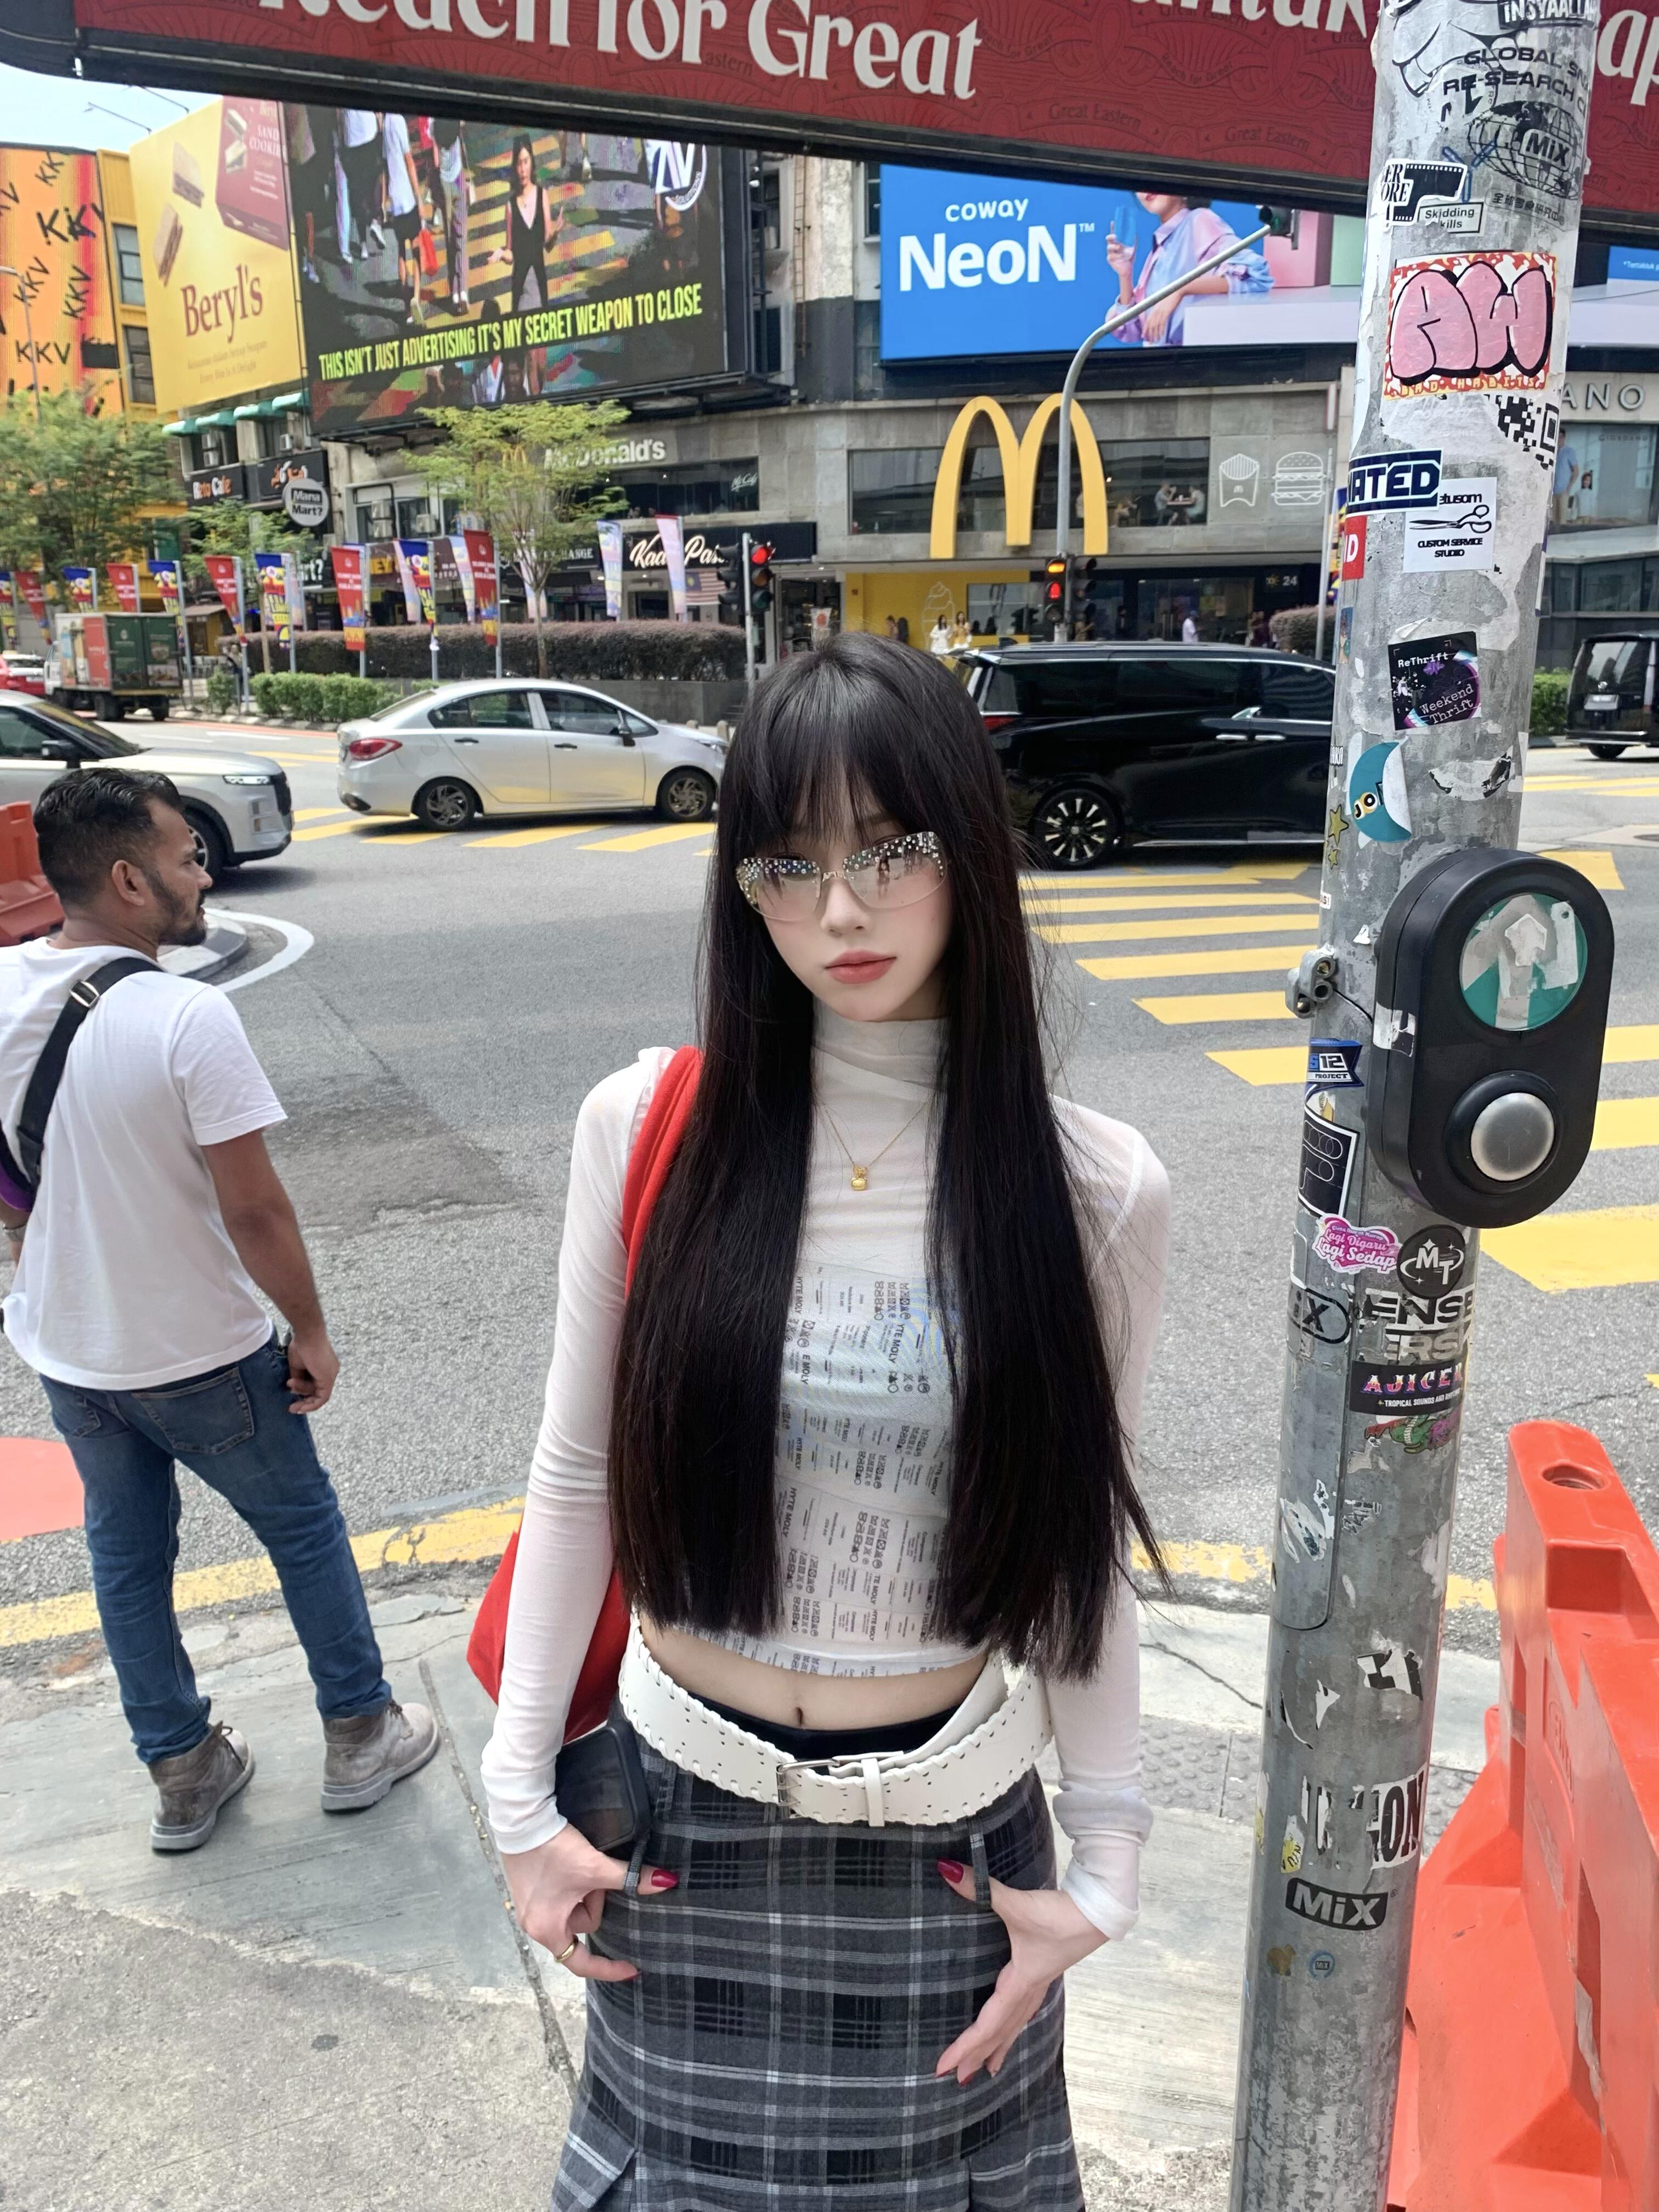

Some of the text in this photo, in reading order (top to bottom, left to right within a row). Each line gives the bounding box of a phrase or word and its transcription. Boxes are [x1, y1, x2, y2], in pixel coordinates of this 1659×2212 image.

[748, 0, 982, 99] Great
[1464, 47, 1562, 69] GLOBAL
[1443, 71, 1575, 101] RE-SEARCH
[1527, 132, 1571, 166] MiX
[945, 198, 1029, 223] coway
[1425, 208, 1475, 219] Skidding
[899, 223, 1077, 292] NeoN
[180, 264, 263, 343] Beryl's
[319, 283, 703, 381] THIS ISN'T JUST ADVERTISING IT'S MY SECRET WEAPON TO CLOSE
[15, 340, 71, 365] KKV
[1401, 375, 1535, 396] BAD HABITS
[1349, 462, 1441, 503] ATED
[292, 489, 322, 501] Mana
[292, 505, 323, 517] Mart?
[1418, 537, 1483, 548] CUSTOM SERVICE
[1435, 550, 1465, 558] STUDIO
[1282, 575, 1298, 586] 24
[1398, 652, 1449, 668] ReThrift
[1419, 684, 1475, 715] Weekend
[1430, 699, 1475, 725] Thrift
[1325, 1229, 1388, 1251] Lagi Digaru
[1316, 1237, 1397, 1271] Lagi Sedap
[888, 1339, 901, 1363] MOLY
[800, 1362, 810, 1385] MOLY
[1413, 1397, 1434, 1406] SOUNDS
[870, 1585, 879, 1605] MOLY
[1293, 1882, 1380, 1926] MiX
